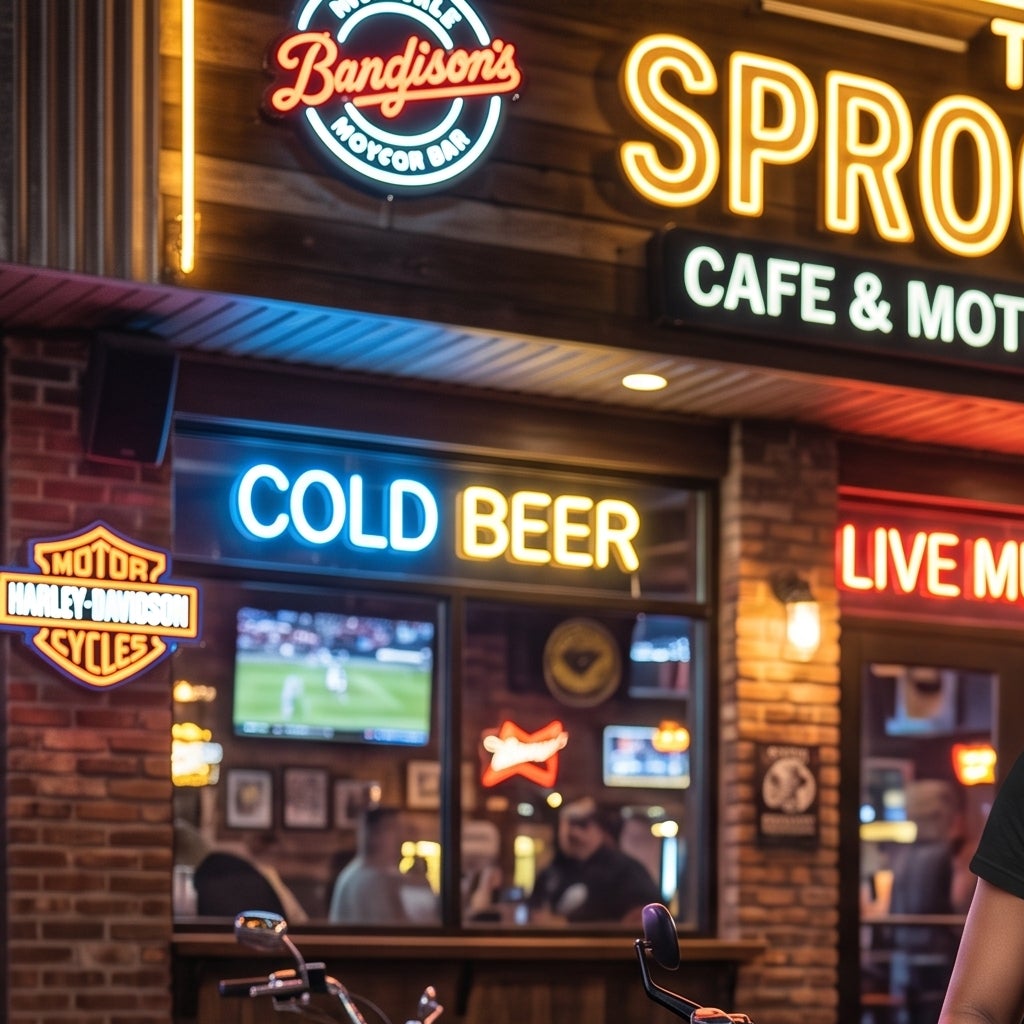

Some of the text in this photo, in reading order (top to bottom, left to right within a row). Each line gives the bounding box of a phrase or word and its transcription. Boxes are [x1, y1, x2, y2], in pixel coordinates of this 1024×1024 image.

[425, 128, 471, 167] BAR
[682, 245, 837, 326] CAFE
[848, 271, 893, 334] &
[235, 463, 642, 573] COLD BEER
[51, 539, 150, 583] MOTOR
[841, 522, 961, 598] LIVE
[50, 628, 149, 676] CYCLES
